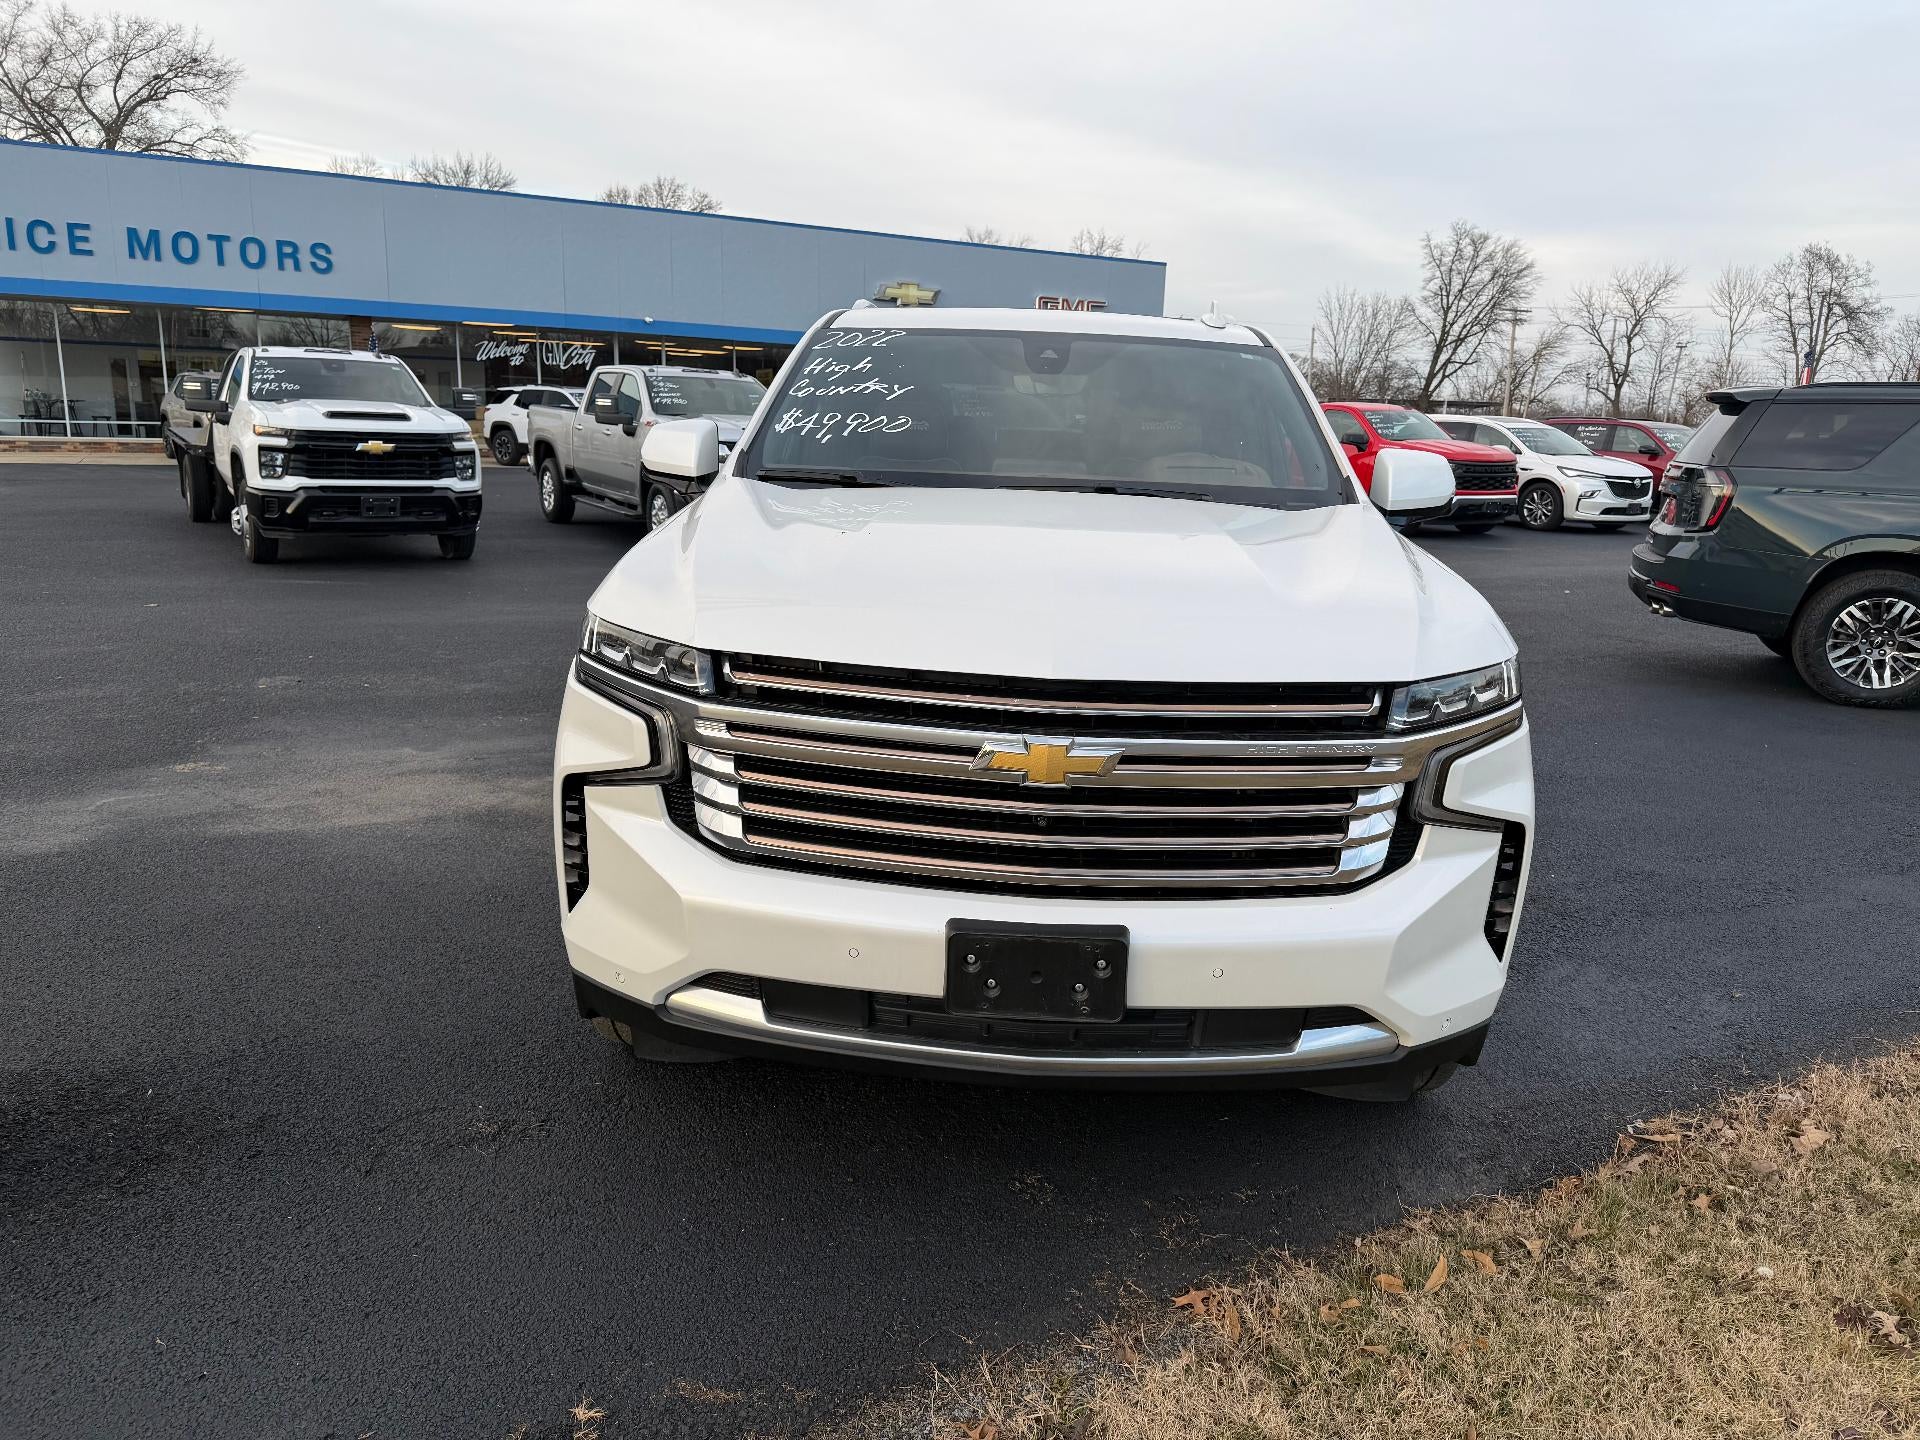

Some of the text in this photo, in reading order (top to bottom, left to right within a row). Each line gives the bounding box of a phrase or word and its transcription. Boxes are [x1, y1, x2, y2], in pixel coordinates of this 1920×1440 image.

[126, 226, 334, 274] MOTORS
[1035, 295, 1108, 311] GMC
[811, 329, 907, 350] 2022
[475, 340, 530, 361] Welcome
[509, 355, 524, 366] to
[543, 341, 597, 370] GM City
[803, 357, 873, 381] High
[774, 408, 912, 444] $49,900
[1296, 744, 1377, 753] COUNTRY
